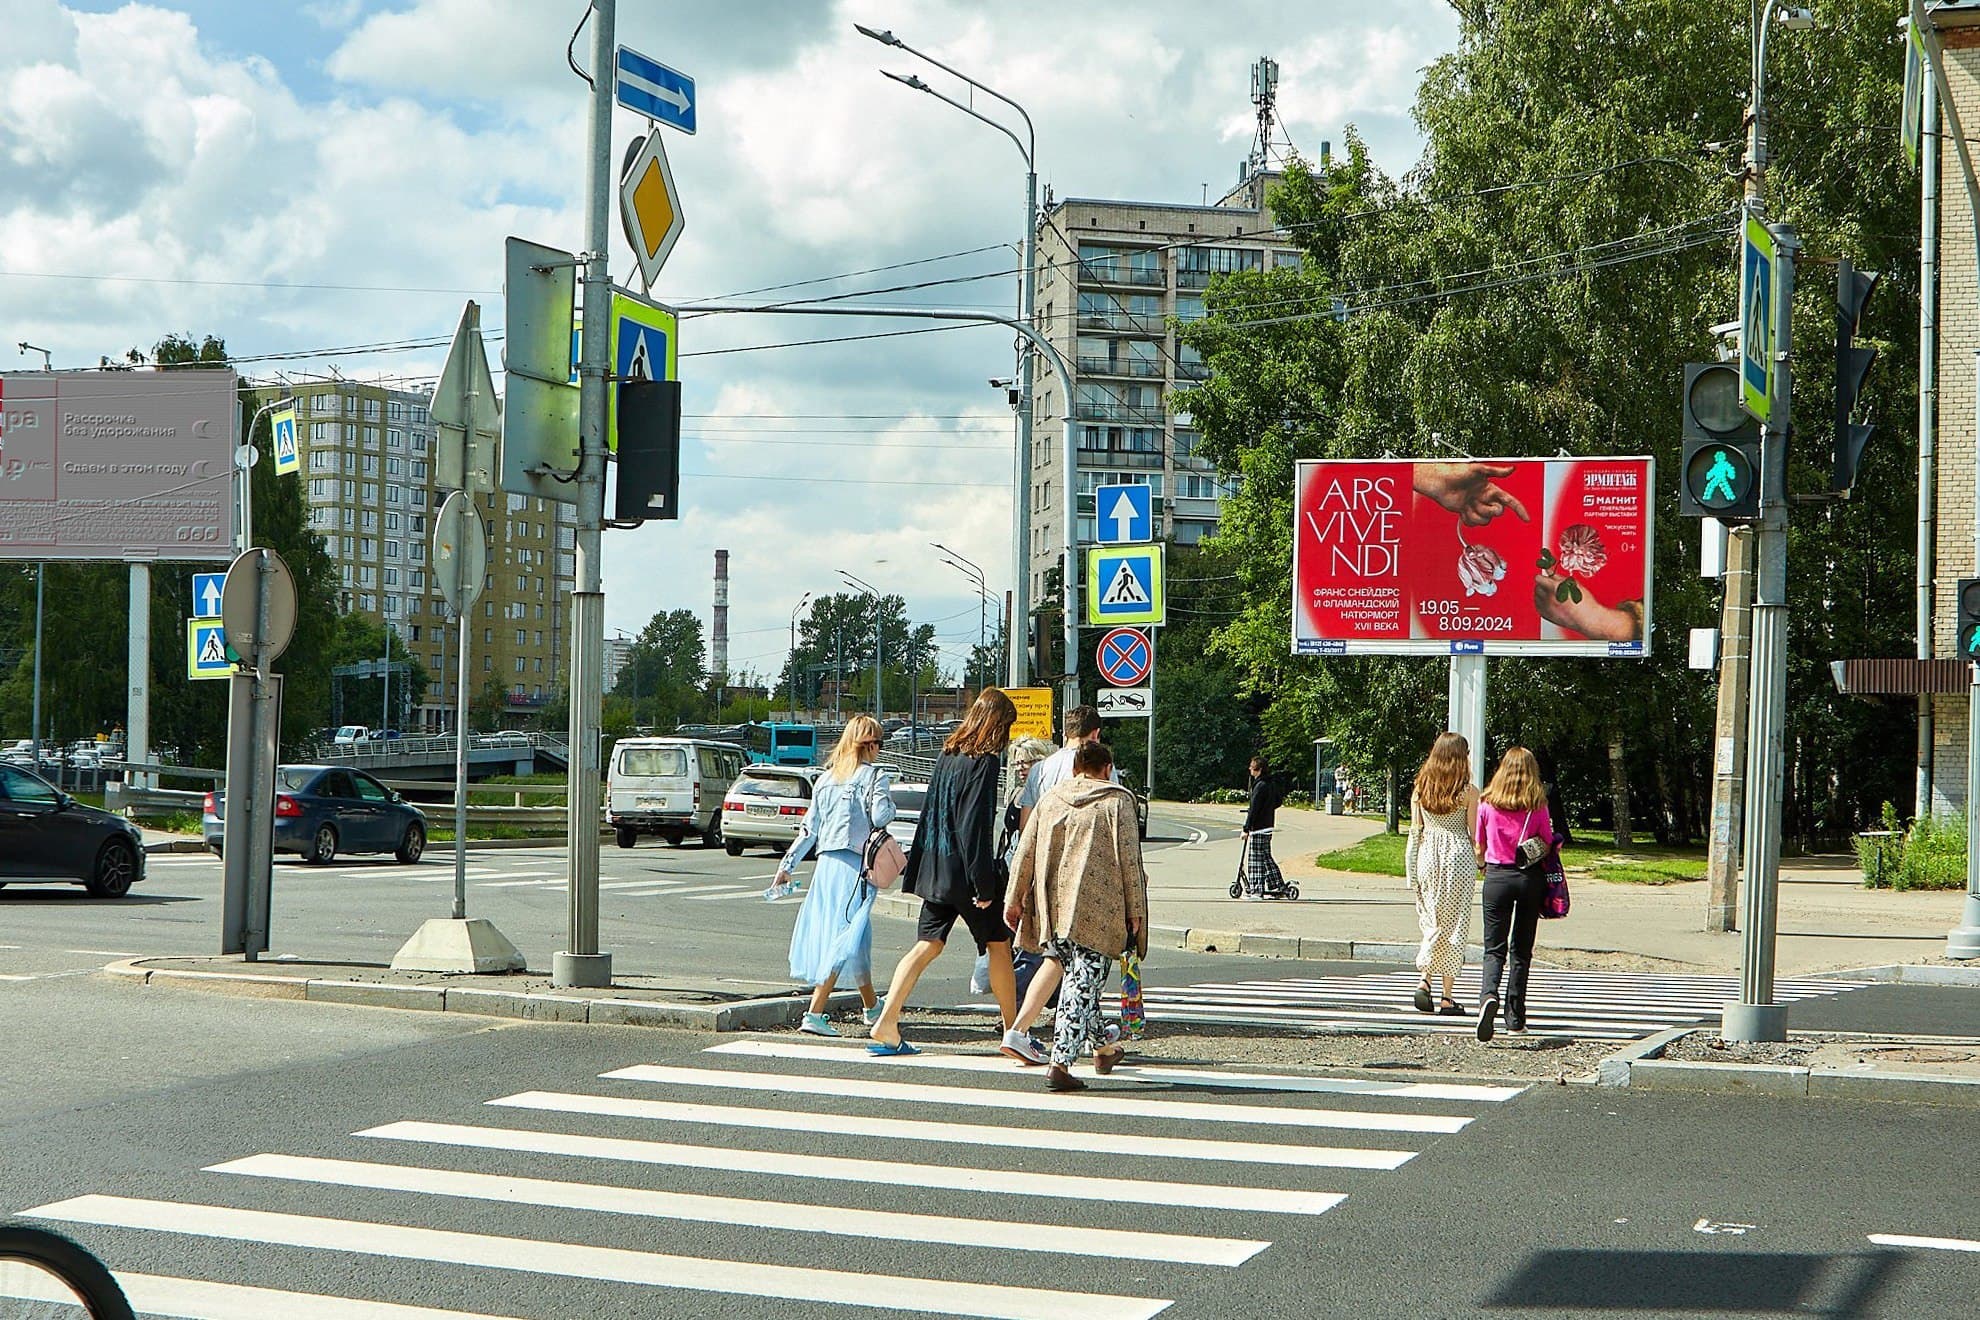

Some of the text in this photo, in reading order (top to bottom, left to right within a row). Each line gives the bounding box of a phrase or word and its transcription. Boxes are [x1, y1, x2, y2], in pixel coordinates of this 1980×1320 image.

[64, 412, 136, 426] Рассрочка
[63, 424, 175, 439] без удорожания
[109, 464, 119, 473] в
[156, 464, 188, 477] году
[1583, 473, 1637, 487] ЭРМИТАЖ
[1318, 477, 1395, 517] ARS
[1596, 496, 1637, 504] МАГНИТ
[1306, 511, 1403, 543] VIVE
[1621, 542, 1637, 552] 0+
[1331, 544, 1398, 576] NDI
[1313, 586, 1400, 598] ФРАНС СНЕЙДЕРС
[1313, 598, 1399, 608] И ФЛАМАНДСКИЙ
[1419, 600, 1459, 615] 19.05
[1340, 611, 1399, 619] НАТЮРМОРТ
[1354, 622, 1399, 631] XVII ВЕКА
[1439, 616, 1513, 631] 8.09.2024
